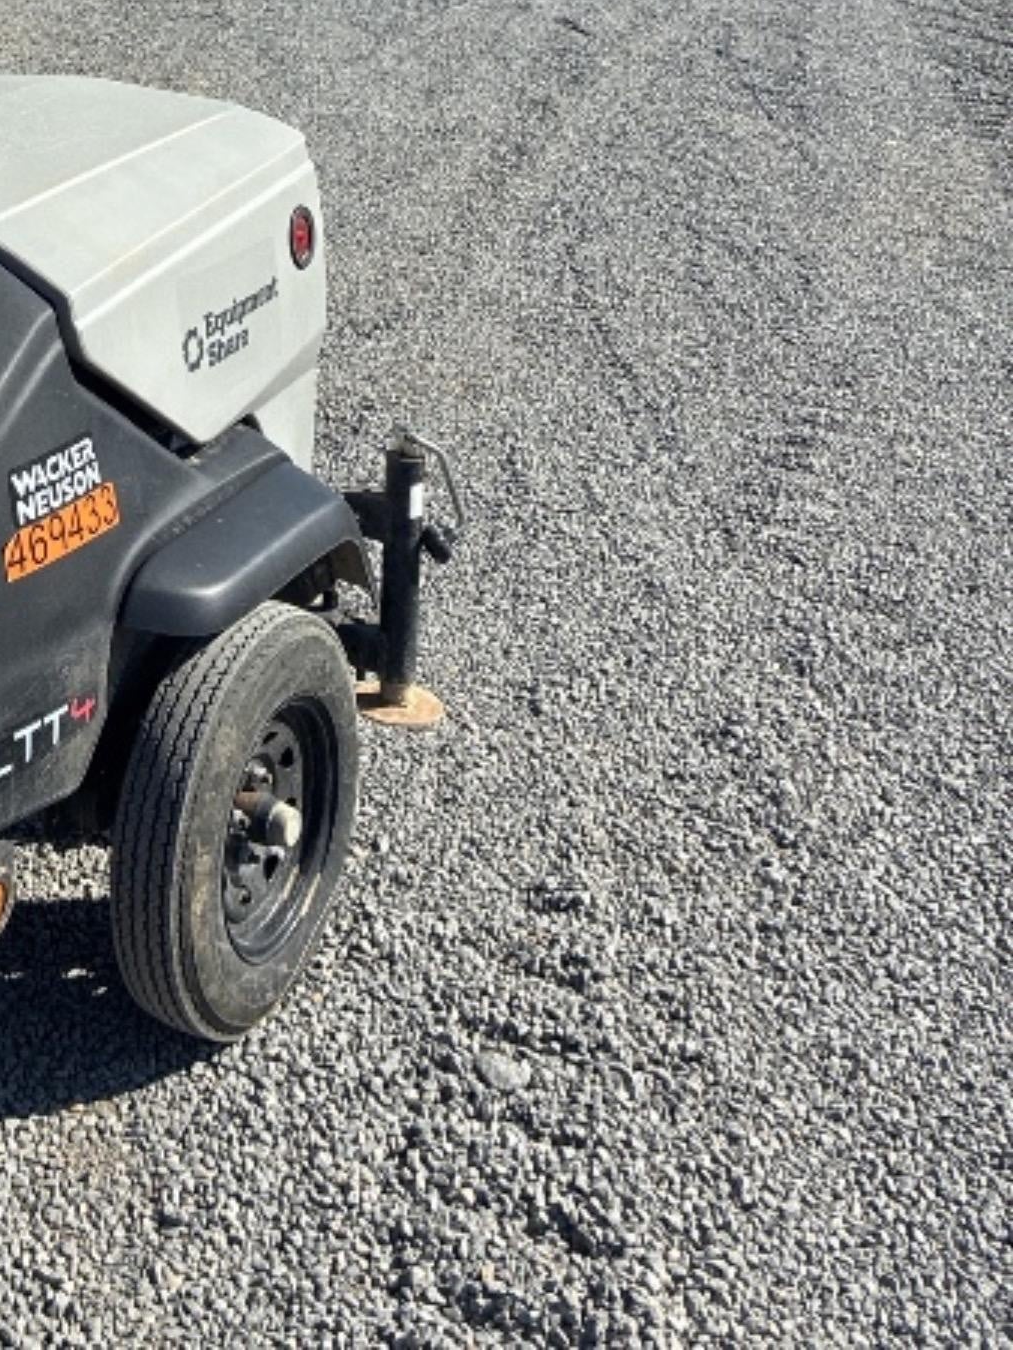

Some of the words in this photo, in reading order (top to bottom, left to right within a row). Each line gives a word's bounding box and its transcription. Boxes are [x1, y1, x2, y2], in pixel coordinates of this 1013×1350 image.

[203, 275, 279, 339] Equipment
[10, 436, 96, 498] WACKER
[16, 461, 102, 526] NEUSON
[8, 485, 119, 571] 469433
